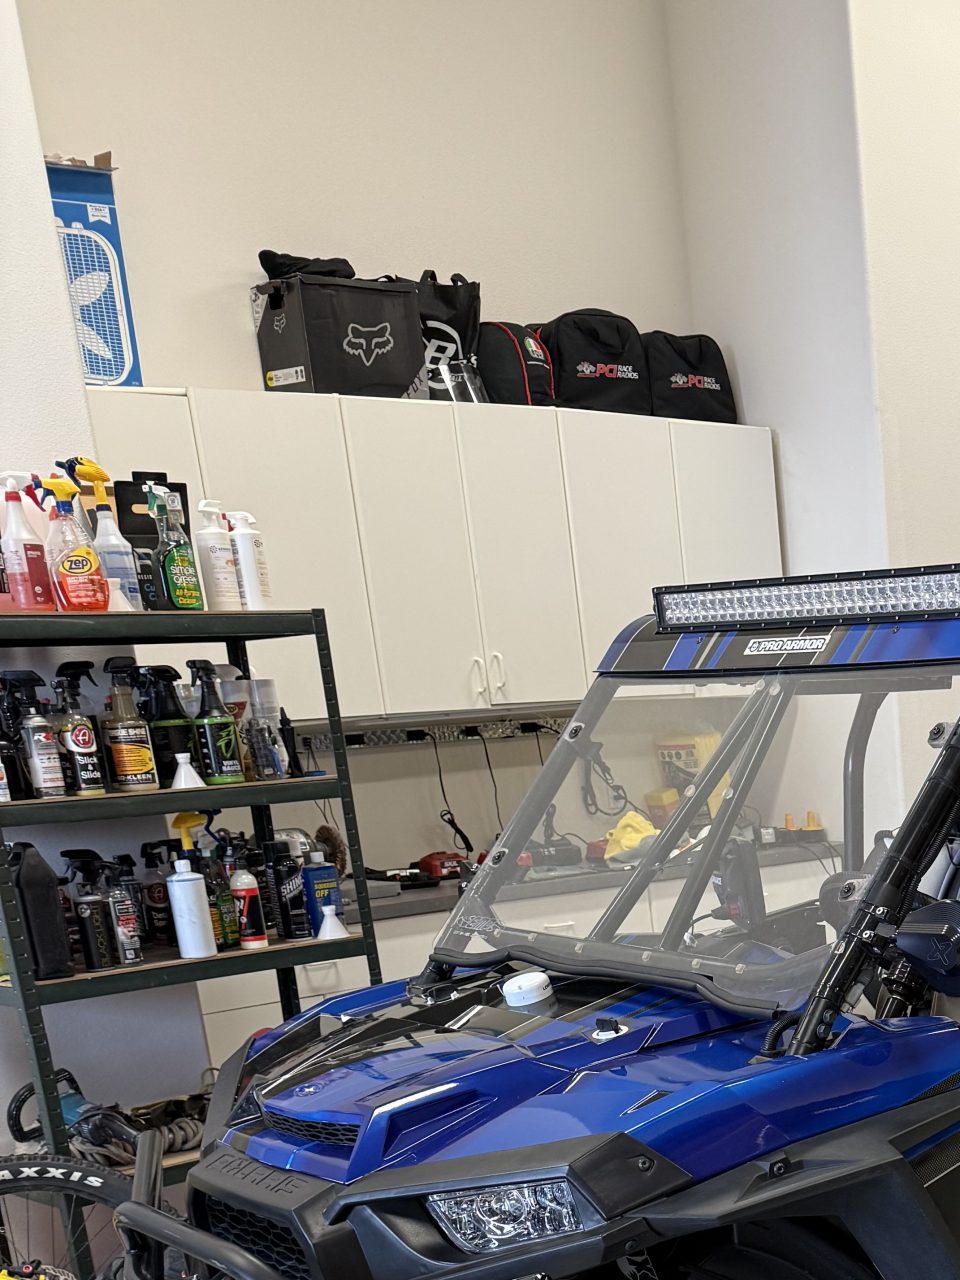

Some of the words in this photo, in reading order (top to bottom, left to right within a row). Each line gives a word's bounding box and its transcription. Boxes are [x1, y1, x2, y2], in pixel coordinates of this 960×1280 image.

[617, 364, 633, 373] RACE
[617, 371, 639, 379] RADIOS
[759, 639, 783, 651] PRO
[781, 638, 823, 650] ARMOR
[78, 756, 99, 764] Slick
[80, 770, 101, 780] Slide
[205, 1153, 309, 1194] POLARIS
